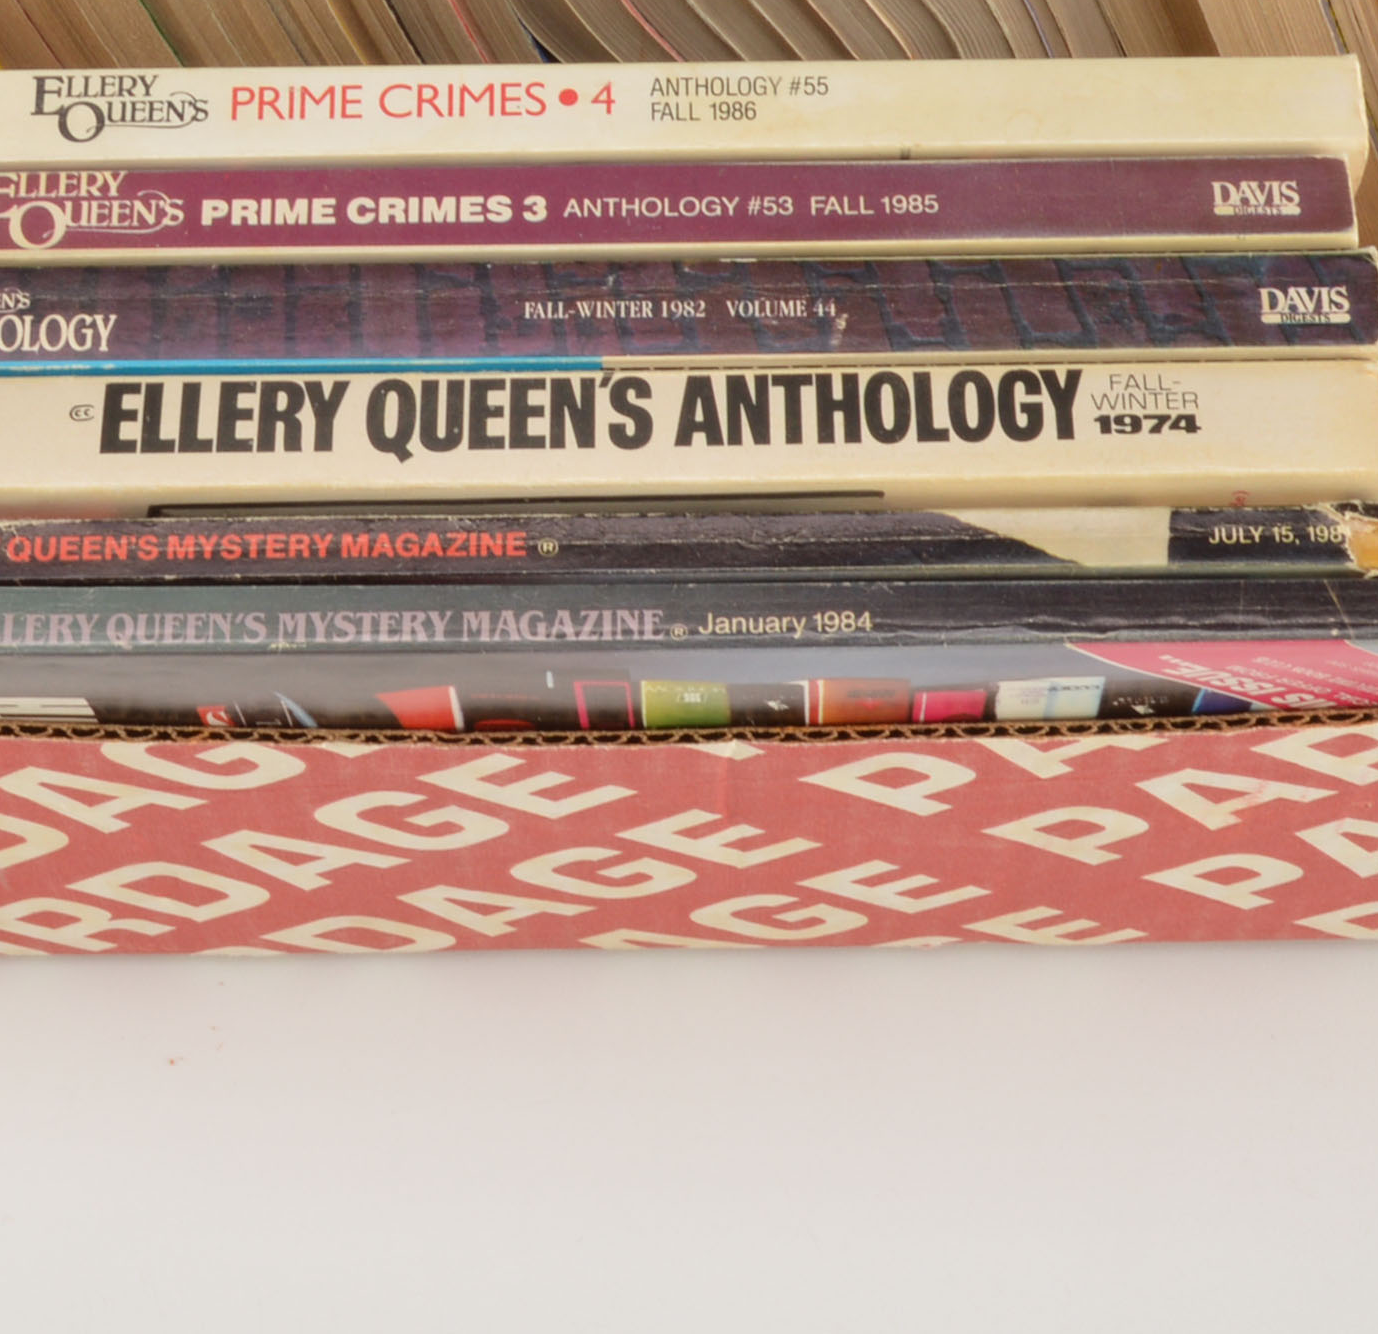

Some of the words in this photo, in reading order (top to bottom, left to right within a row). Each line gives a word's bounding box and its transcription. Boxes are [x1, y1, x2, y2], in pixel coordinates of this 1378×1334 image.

[31, 76, 158, 116] ELLERY
[231, 85, 363, 120] PRIME
[378, 81, 547, 118] CRIMES
[589, 81, 615, 115] 4
[649, 75, 782, 98] ANTHOLOGY
[788, 75, 829, 97] #55
[58, 92, 210, 143] QUEEN'S
[649, 101, 700, 122] FALL
[707, 100, 757, 121] 1986
[1212, 179, 1300, 206] DAVIS
[9, 195, 184, 248] QUEEN'S
[201, 199, 337, 226] PRIME
[347, 197, 512, 224] CRIMES
[521, 196, 546, 222] 3
[563, 197, 739, 216] ANTHOLOGY
[746, 197, 794, 216] #53
[810, 196, 874, 214] FALL
[880, 195, 939, 214] 1985
[525, 300, 653, 319] FALL-WINTER
[659, 300, 706, 319] 1982
[726, 299, 807, 318] VOLUME
[812, 299, 836, 317] 44
[1260, 286, 1350, 314] DAVIS
[1108, 374, 1182, 391] FALL-
[99, 380, 349, 454] ELLERY
[365, 375, 653, 463] QUEEN'S
[674, 369, 1083, 447] ANTHOLOGY
[1091, 391, 1200, 410] WINTER
[1093, 414, 1201, 436] 1974
[7, 535, 159, 563] QUEEN'S
[166, 534, 333, 561] MYSTERY
[340, 532, 526, 558] MAGAZINE
[1208, 526, 1266, 545] JULY
[1273, 526, 1306, 547] 15,
[106, 612, 266, 648] QUEEN'S
[278, 611, 451, 644] MYSTERY
[461, 608, 664, 641] MAGAZINE
[698, 611, 806, 639] January
[812, 610, 873, 632] 1984
